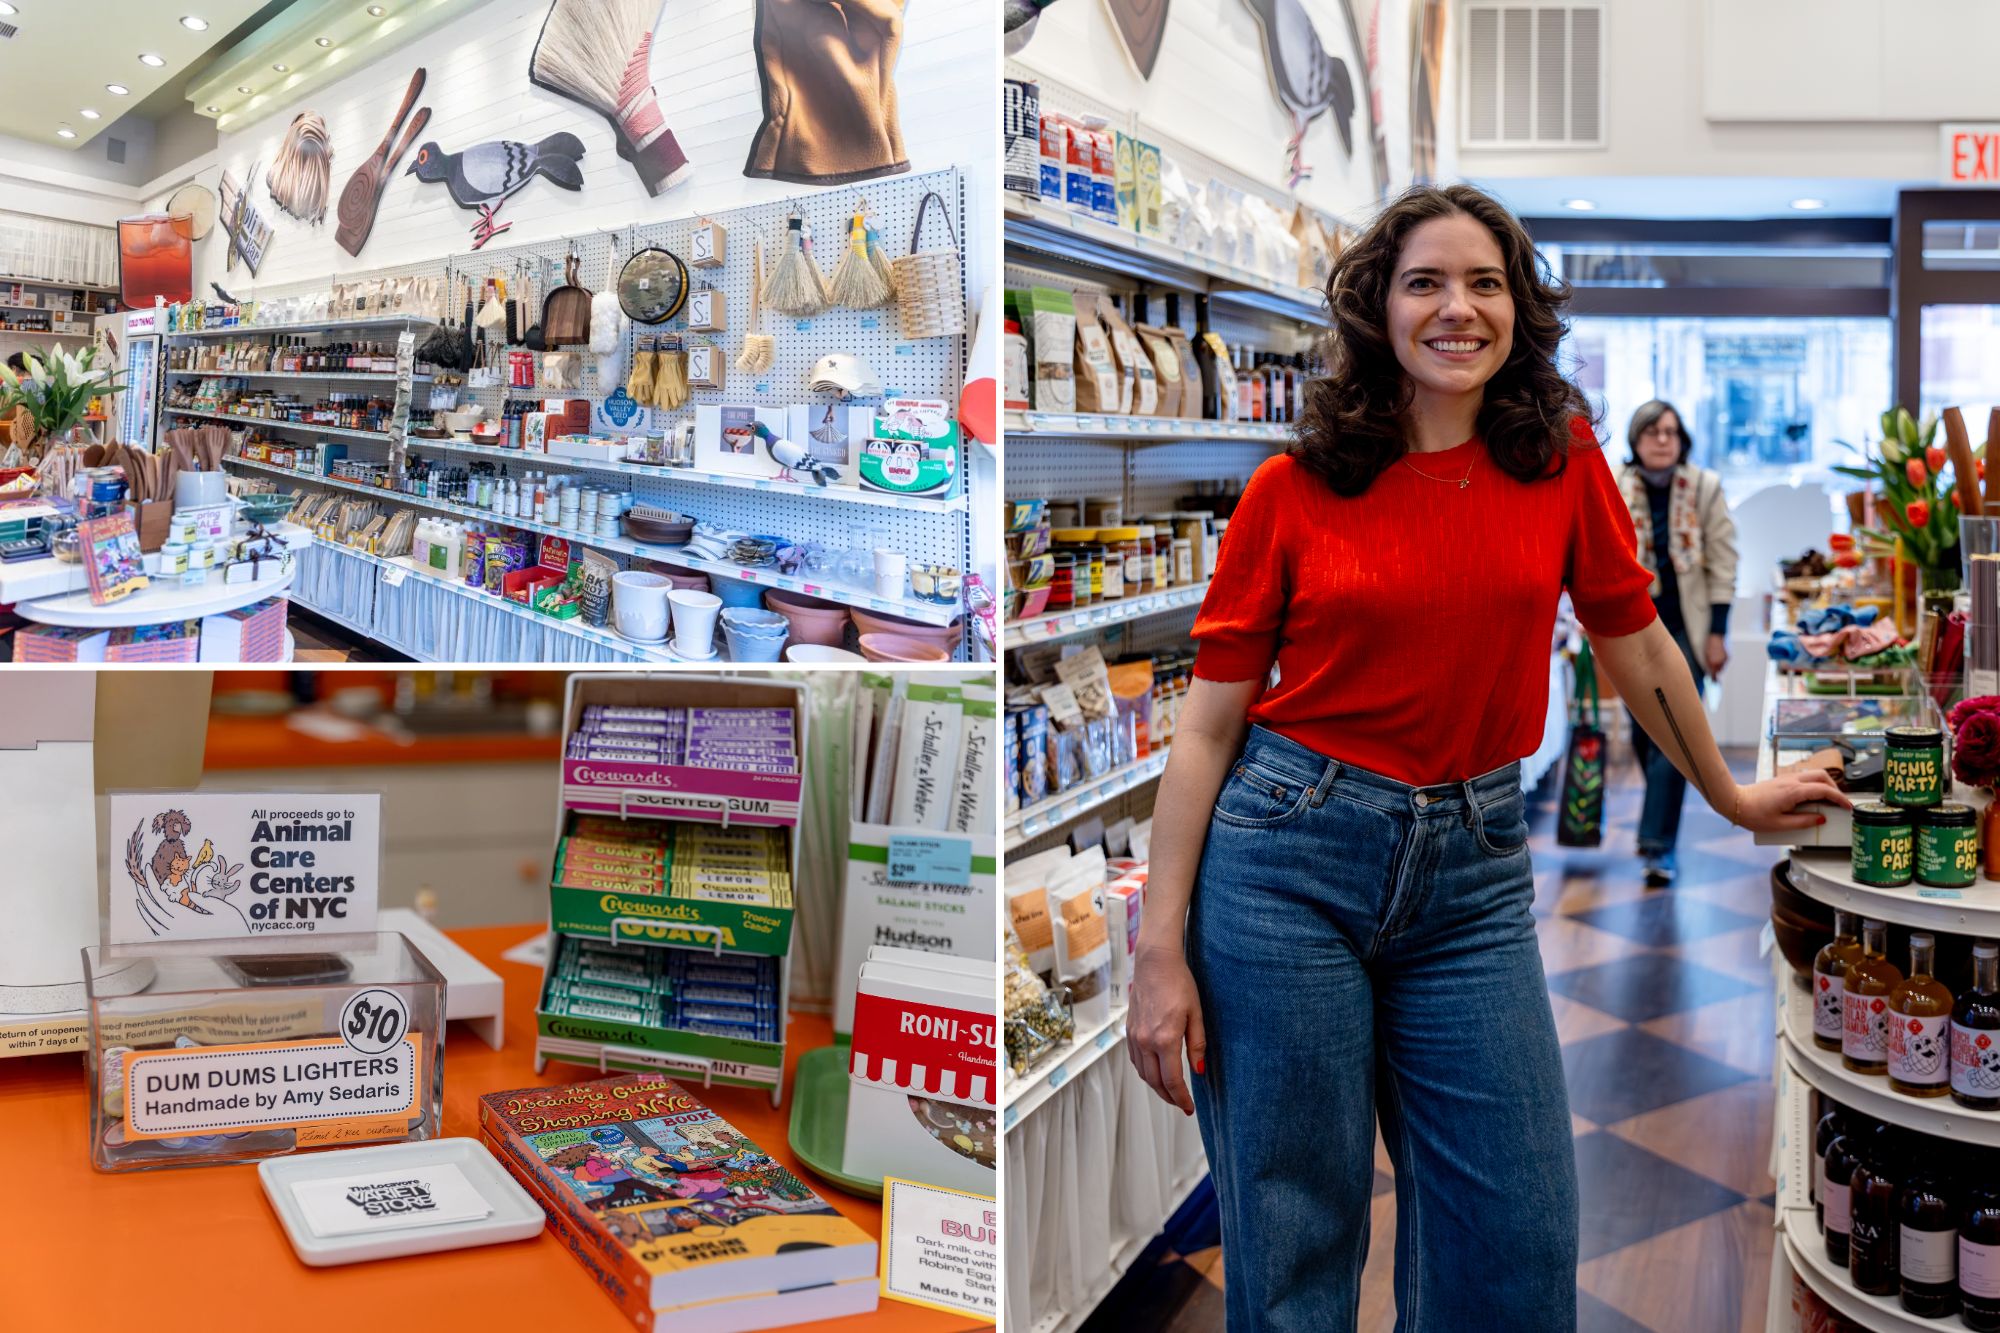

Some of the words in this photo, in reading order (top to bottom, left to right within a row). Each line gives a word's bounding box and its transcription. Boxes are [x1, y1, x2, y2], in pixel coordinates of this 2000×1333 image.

[197, 511, 220, 520] pring
[198, 520, 219, 529] ALE
[586, 573, 604, 588] BK
[921, 716, 943, 768] Schaller
[964, 731, 986, 783] Schaller
[1887, 758, 1935, 777] PICNIC
[1888, 774, 1938, 792] PARTY
[729, 799, 769, 813] GUM
[914, 777, 936, 818] Weber
[251, 809, 266, 819] All
[270, 809, 324, 821] proceeds
[327, 811, 341, 821] go
[344, 810, 355, 819] to
[957, 792, 978, 834] Weber
[250, 820, 352, 842] Animal
[250, 846, 315, 868] Care
[595, 846, 642, 859] GUAVA
[593, 863, 641, 876] GUAVA
[250, 872, 355, 894] Centers
[591, 880, 641, 892] GUAVA
[707, 875, 753, 884] LEMON
[708, 891, 755, 901] LEMON
[249, 898, 279, 920] of
[285, 897, 347, 919] NYC
[251, 921, 315, 931] nycacc.org
[742, 910, 780, 927] Tropical
[743, 920, 773, 934] Candy
[876, 924, 953, 949] Hudson
[348, 997, 399, 1043] $10
[28, 1028, 38, 1036] of
[9, 1040, 36, 1049] within
[39, 1038, 44, 1046] 7
[46, 1037, 67, 1048] days
[69, 1035, 79, 1044] of
[147, 1072, 200, 1093] DUM
[208, 1066, 276, 1088] DUMS
[283, 1057, 399, 1082] LIGHTERS
[145, 1094, 250, 1116] Handmade
[255, 1092, 277, 1110] by
[283, 1089, 324, 1106] Amy
[329, 1081, 400, 1101] Sedaris
[508, 1092, 608, 1115] Locavore
[613, 1081, 670, 1099] Guide
[565, 1086, 592, 1094] The
[520, 1107, 633, 1132] Shopping
[635, 1095, 692, 1116] NYC
[662, 1110, 715, 1127] BOOK
[540, 1131, 577, 1142] GRAND
[370, 1178, 420, 1190] Locavore
[346, 1182, 432, 1206] VARIETY
[612, 1196, 649, 1208] TAXI
[364, 1195, 437, 1215] STORE
[916, 1235, 945, 1249] Dark
[947, 1242, 973, 1255] milk
[924, 1247, 969, 1265] infused
[919, 1256, 964, 1275] Robin's
[966, 1267, 992, 1282] Egg
[920, 1282, 959, 1298] Made
[962, 1291, 980, 1304] by
